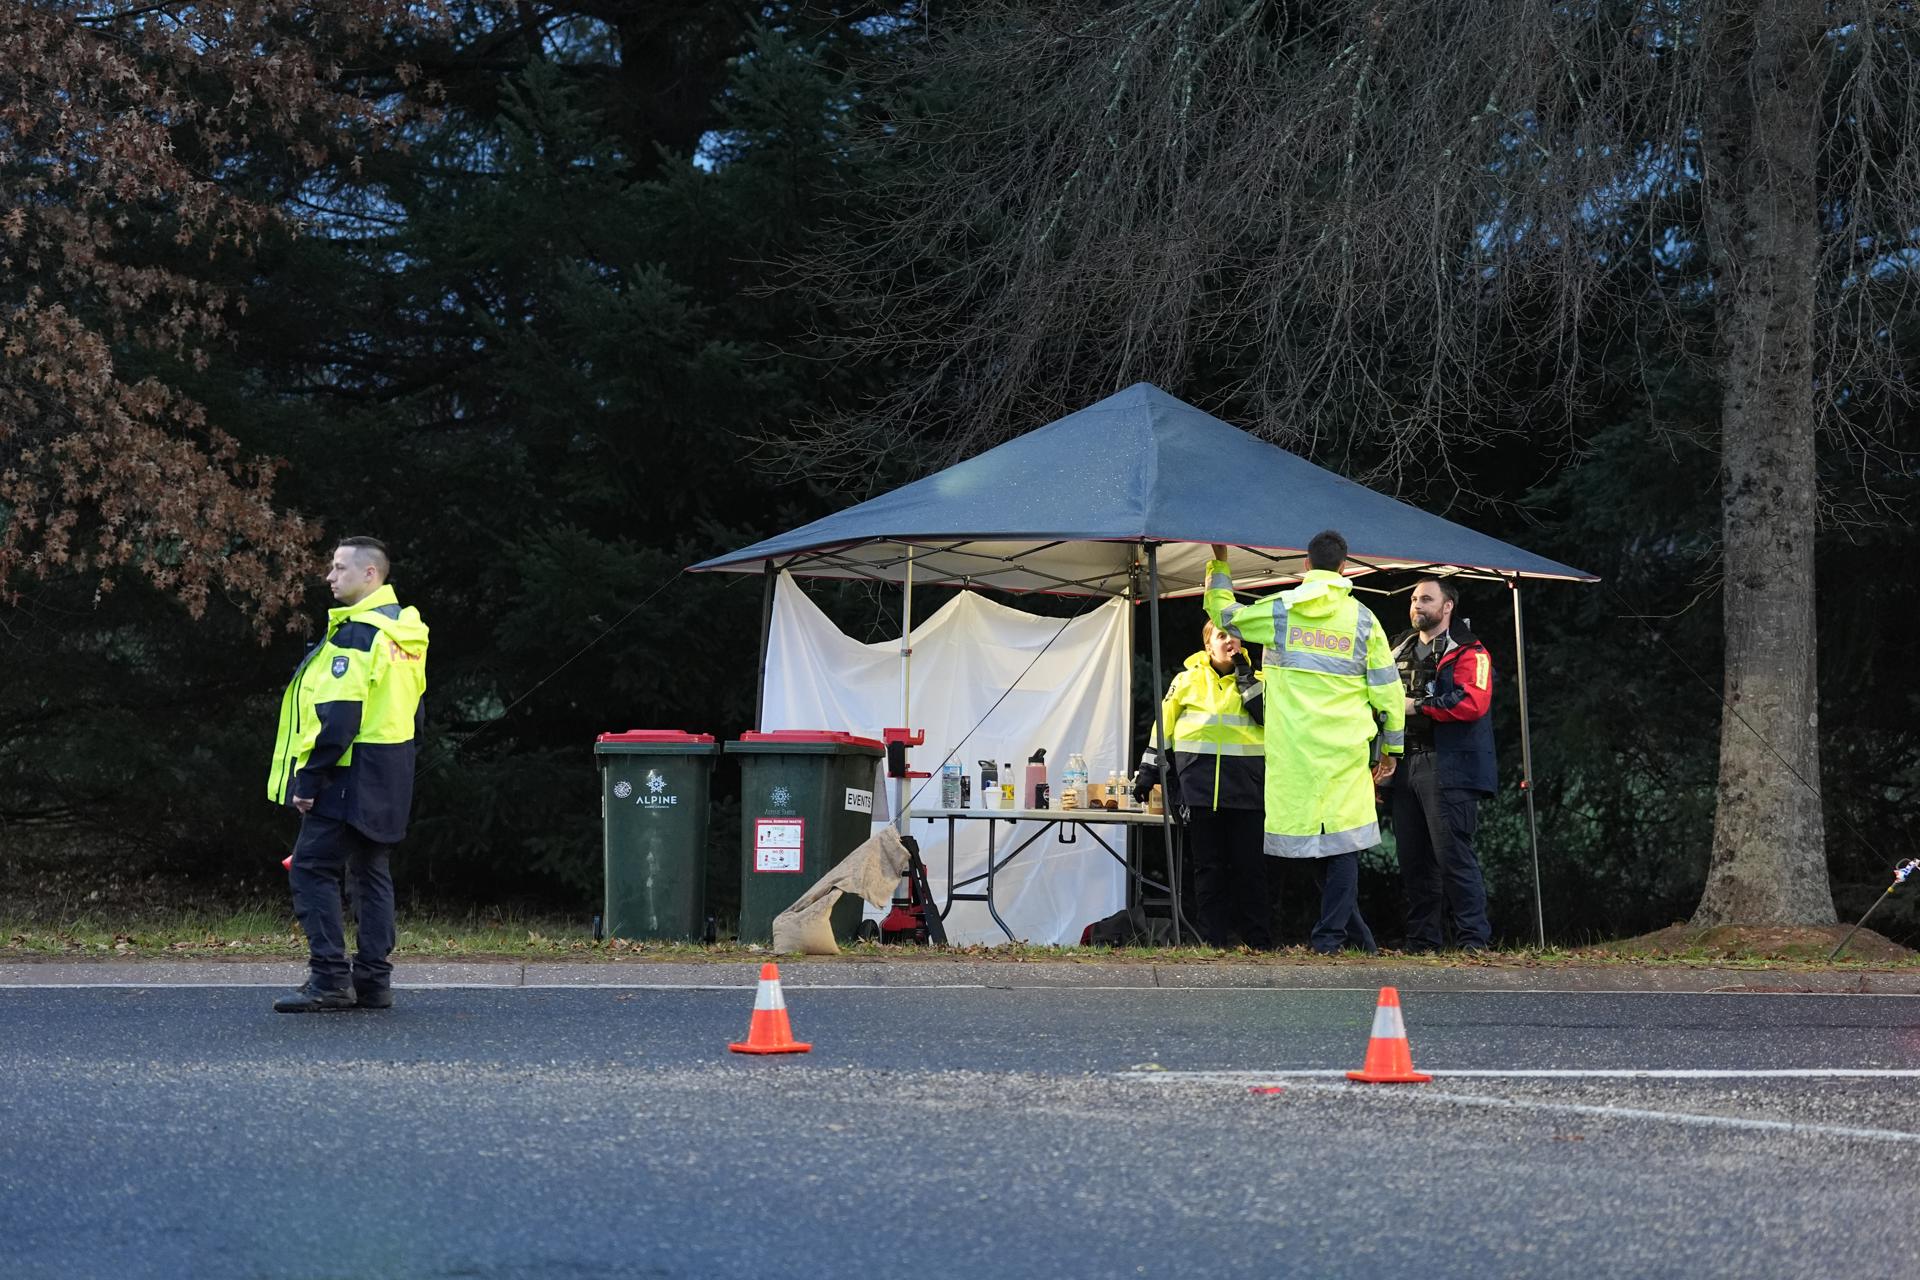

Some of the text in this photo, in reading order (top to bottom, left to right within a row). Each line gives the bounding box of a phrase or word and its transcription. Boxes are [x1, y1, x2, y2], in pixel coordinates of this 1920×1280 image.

[1289, 627, 1350, 651] Police
[636, 796, 677, 804] ALPINE
[847, 793, 871, 808] EVENTS
